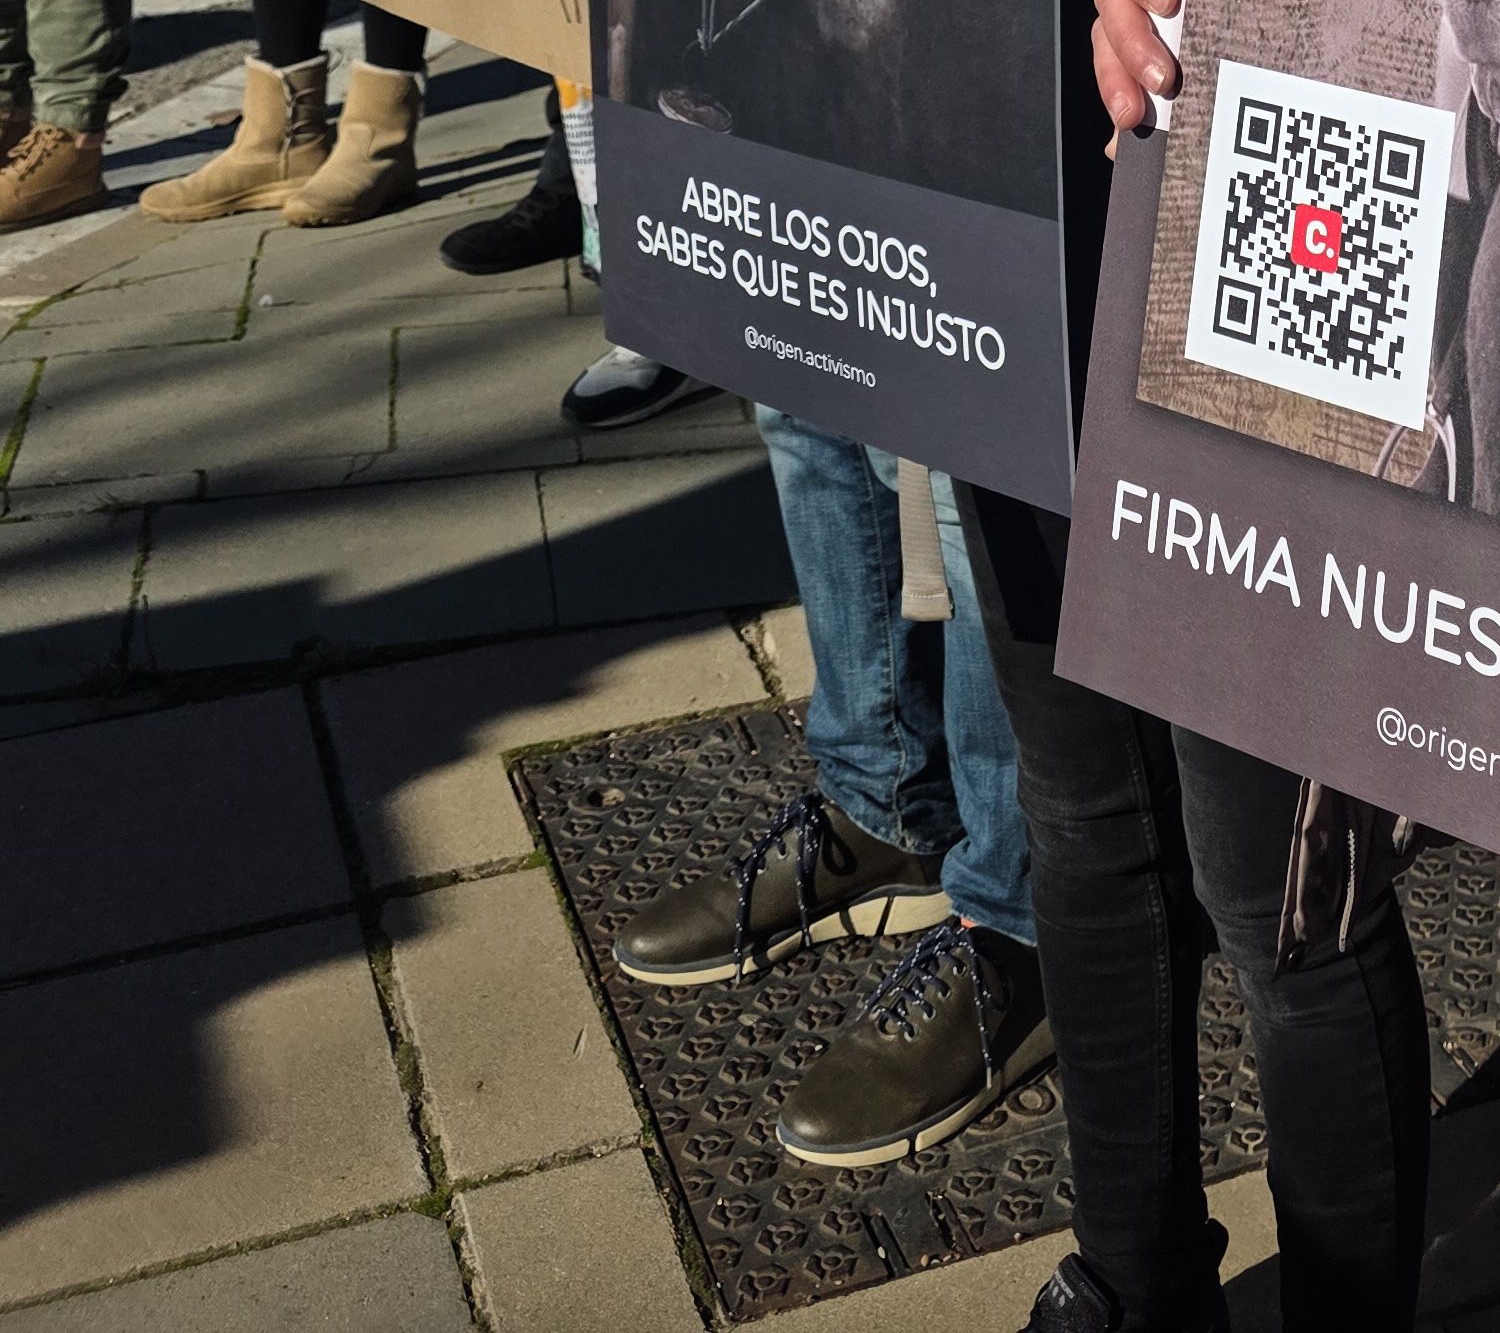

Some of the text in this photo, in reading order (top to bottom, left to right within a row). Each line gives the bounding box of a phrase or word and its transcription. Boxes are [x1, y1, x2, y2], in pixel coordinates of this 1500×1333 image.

[636, 214, 1006, 371] SABES QUE ES INJUSTO
[682, 176, 937, 298] ABRE LOS OJOS,
[743, 325, 876, 388] @origen.activismo
[1112, 480, 1301, 608] FIRMA
